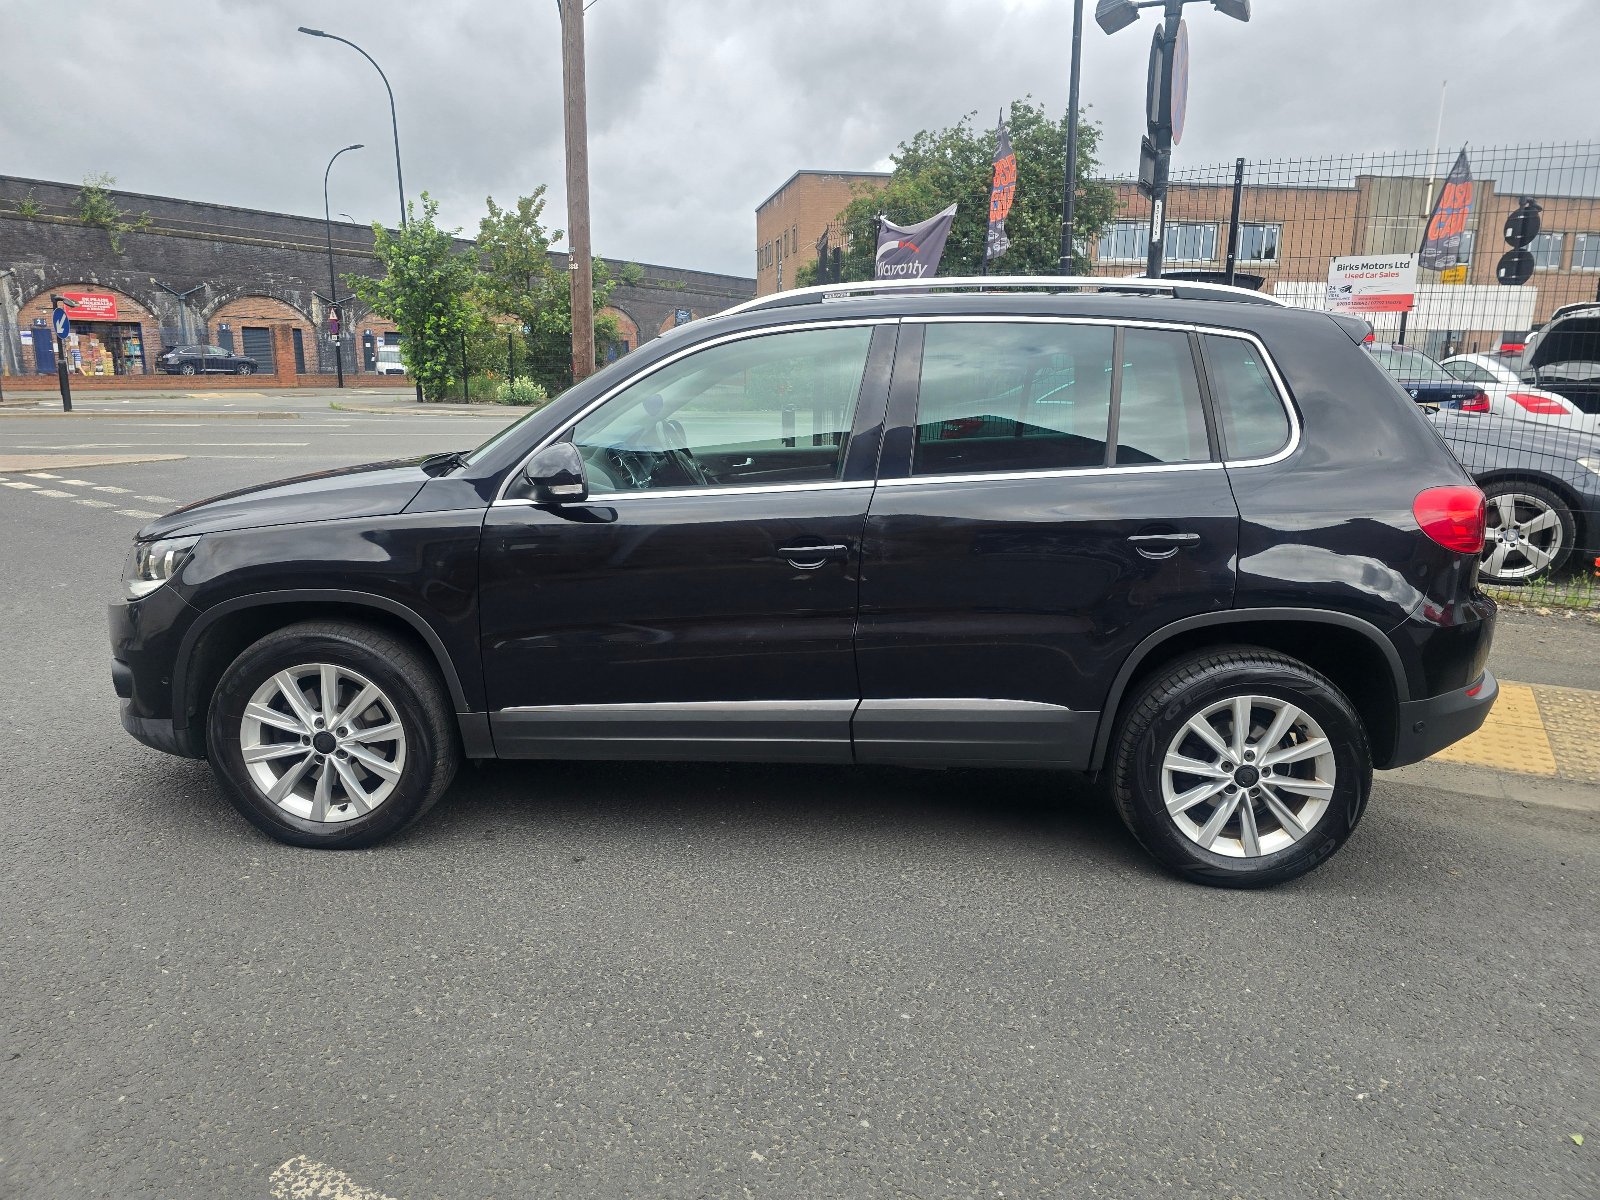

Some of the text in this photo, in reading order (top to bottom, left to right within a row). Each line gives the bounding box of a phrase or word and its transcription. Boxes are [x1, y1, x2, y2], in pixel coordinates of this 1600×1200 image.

[1336, 260, 1411, 272] Birks Motors Ltd
